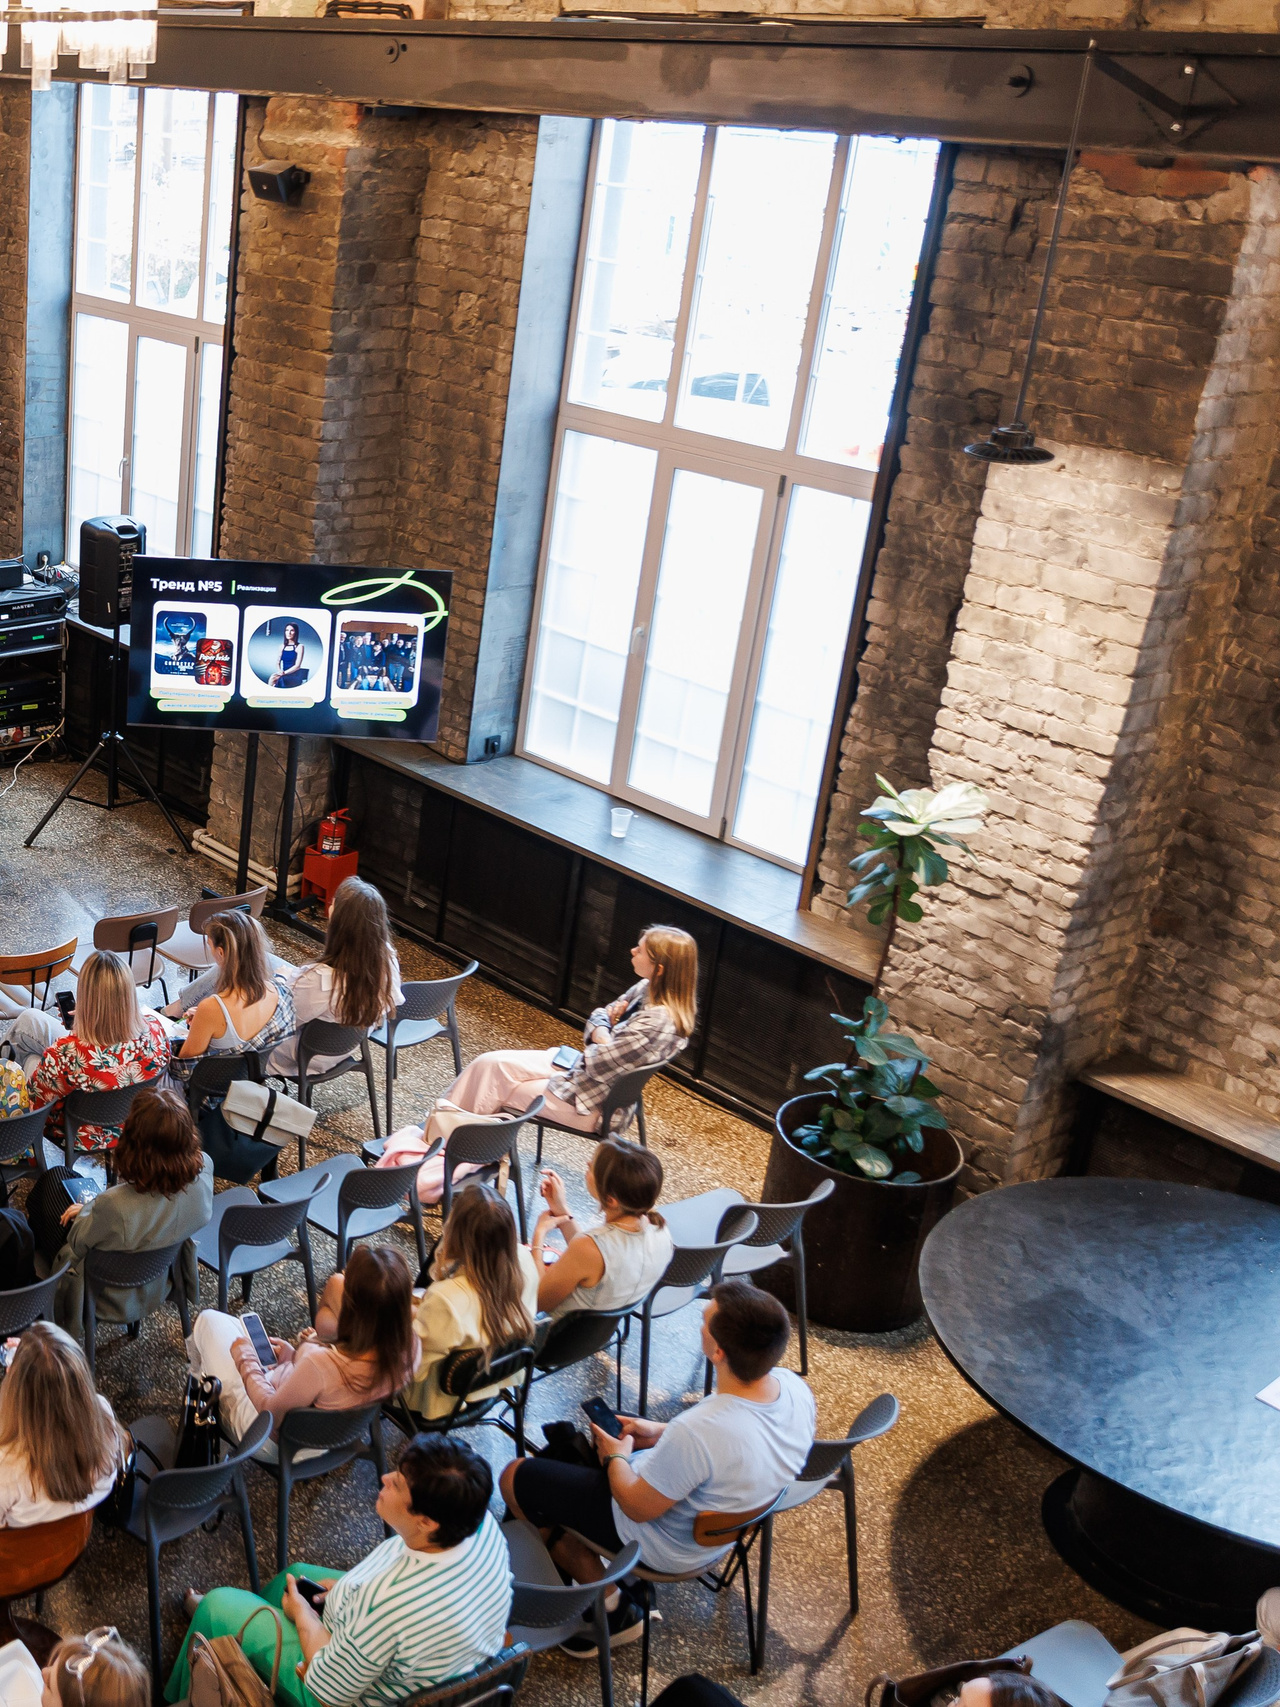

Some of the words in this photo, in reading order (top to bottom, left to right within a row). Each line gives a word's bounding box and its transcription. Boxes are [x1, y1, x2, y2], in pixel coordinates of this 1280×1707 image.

[150, 578, 195, 592] Тренд
[198, 580, 223, 592] №5
[237, 584, 277, 592] Реализация
